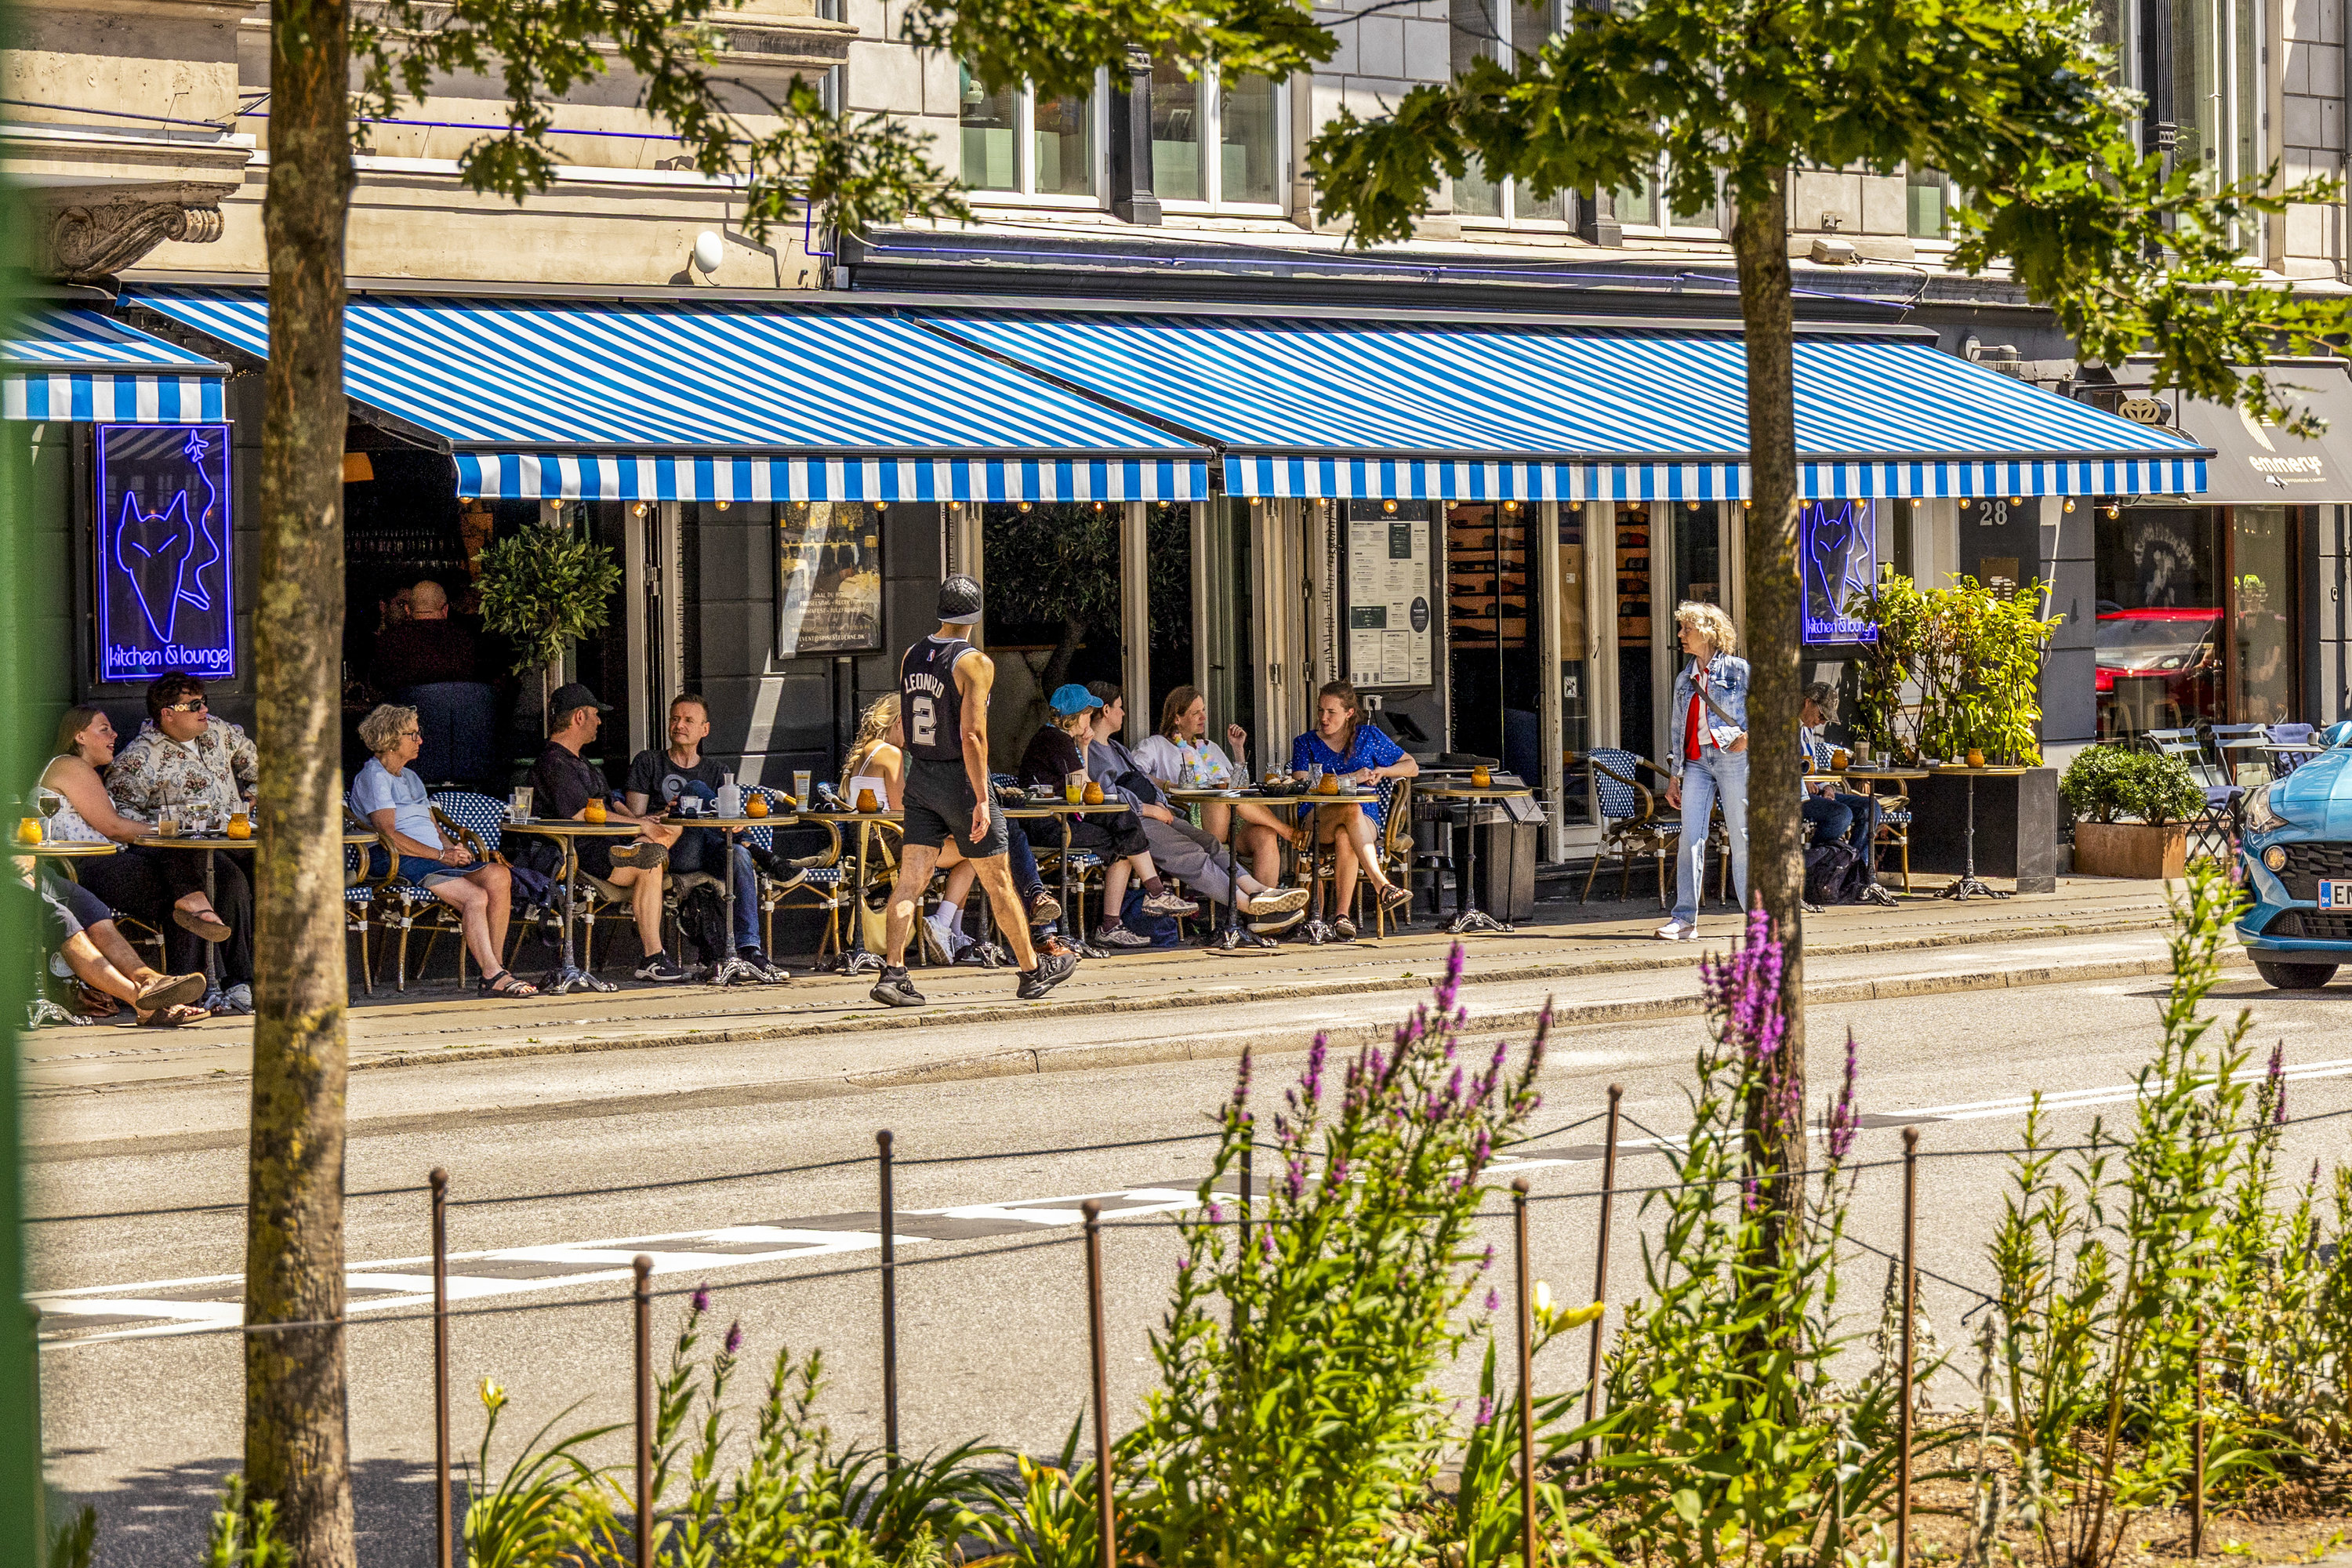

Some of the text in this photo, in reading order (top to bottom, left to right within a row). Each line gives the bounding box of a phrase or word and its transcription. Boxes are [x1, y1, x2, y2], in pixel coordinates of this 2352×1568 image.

[2248, 456, 2323, 476] emmerys
[1980, 500, 2008, 526] 28
[1808, 616, 1837, 633] kitchen
[1838, 617, 1847, 633] &
[109, 644, 230, 669] kitchen & lounge
[913, 695, 937, 746] 2
